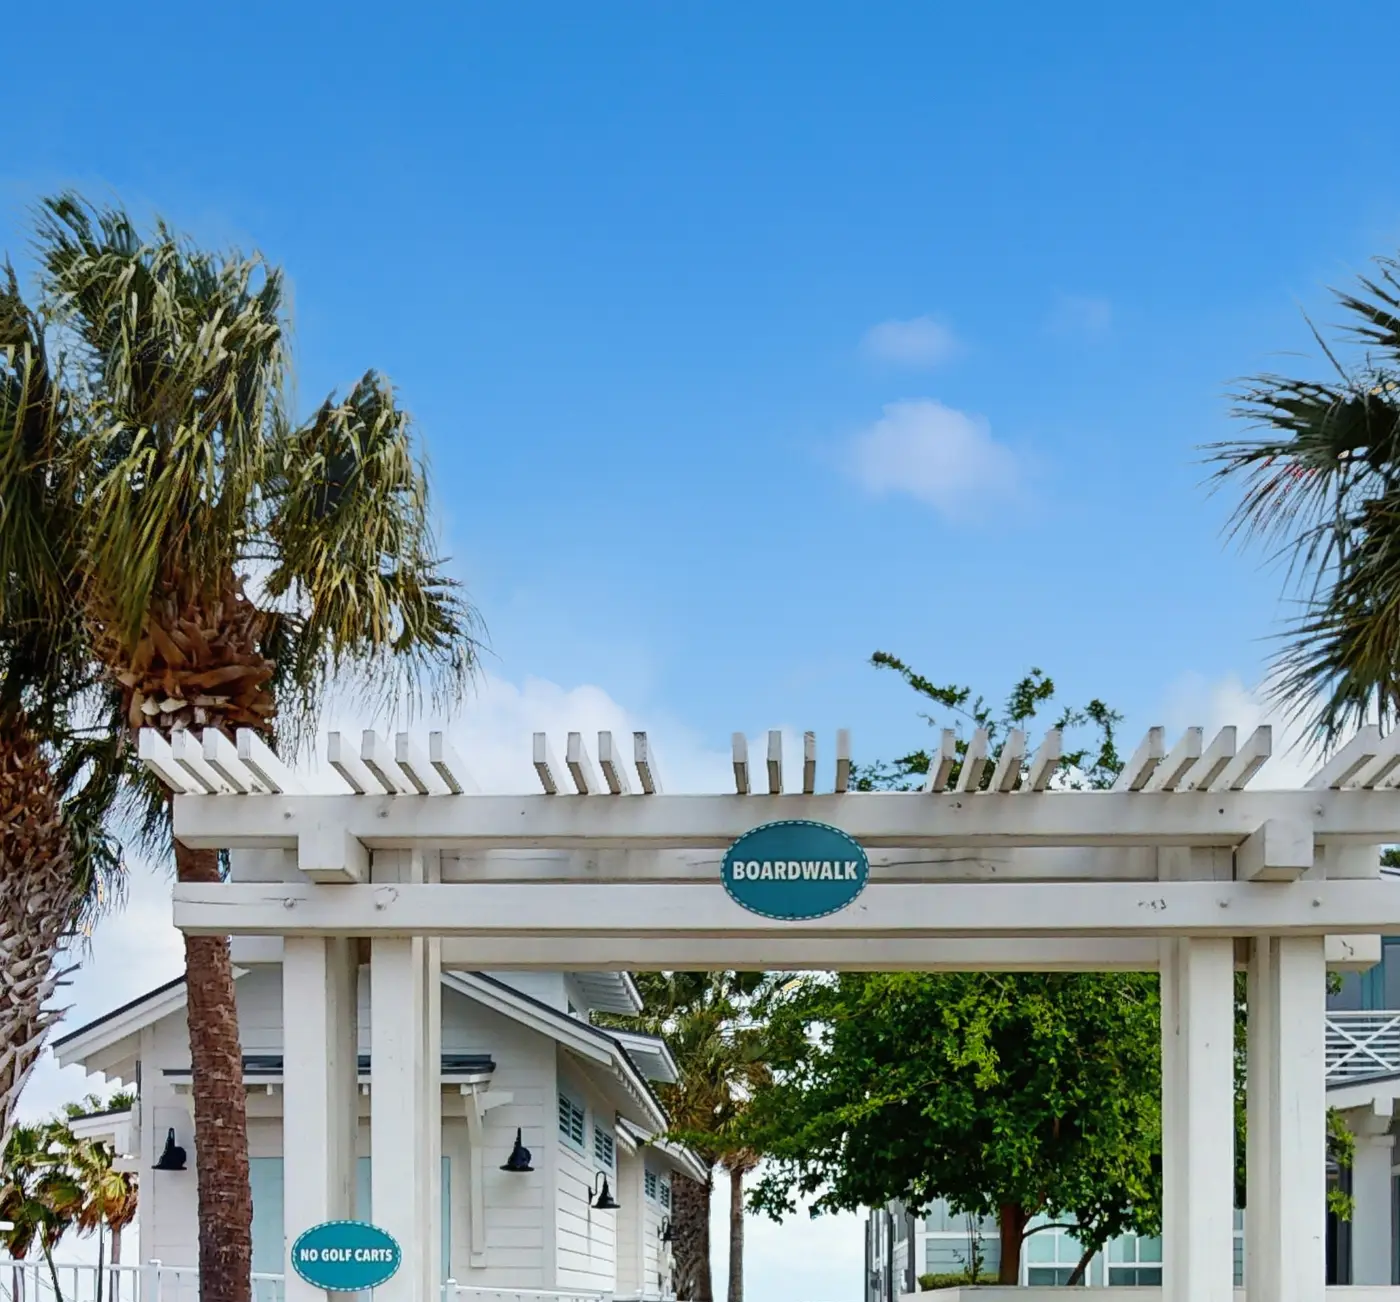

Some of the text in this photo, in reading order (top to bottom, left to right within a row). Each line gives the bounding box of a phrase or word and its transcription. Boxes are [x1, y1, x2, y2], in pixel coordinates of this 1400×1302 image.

[732, 860, 858, 880] BOARDWALK
[300, 1248, 393, 1262] NO GOLF CARTS
